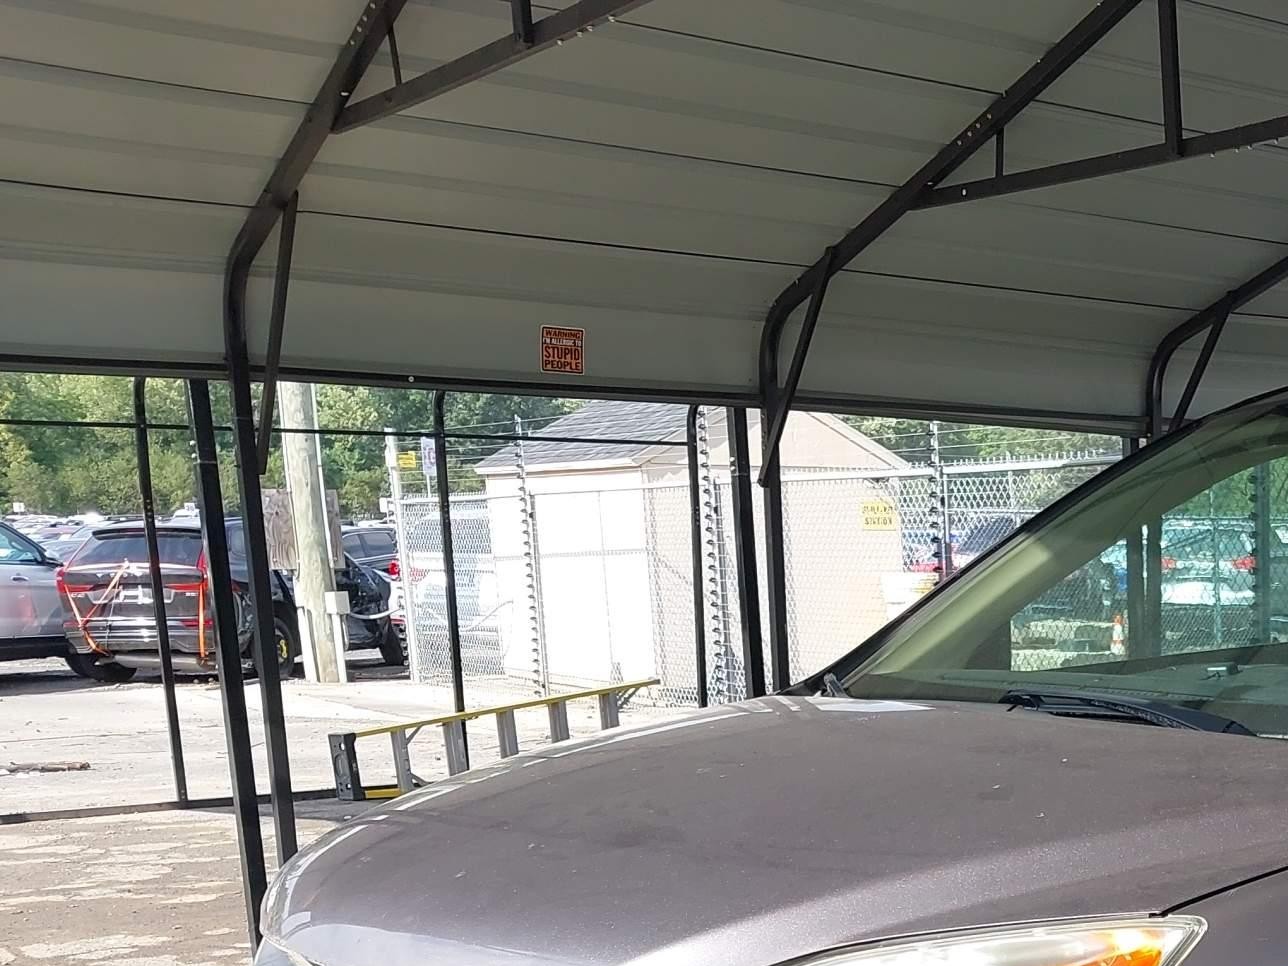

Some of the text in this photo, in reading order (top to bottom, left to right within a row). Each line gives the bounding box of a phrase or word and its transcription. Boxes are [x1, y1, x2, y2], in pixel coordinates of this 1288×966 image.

[544, 329, 581, 339] WARNING
[544, 345, 580, 361] STUPID
[544, 359, 581, 371] PEOPLE
